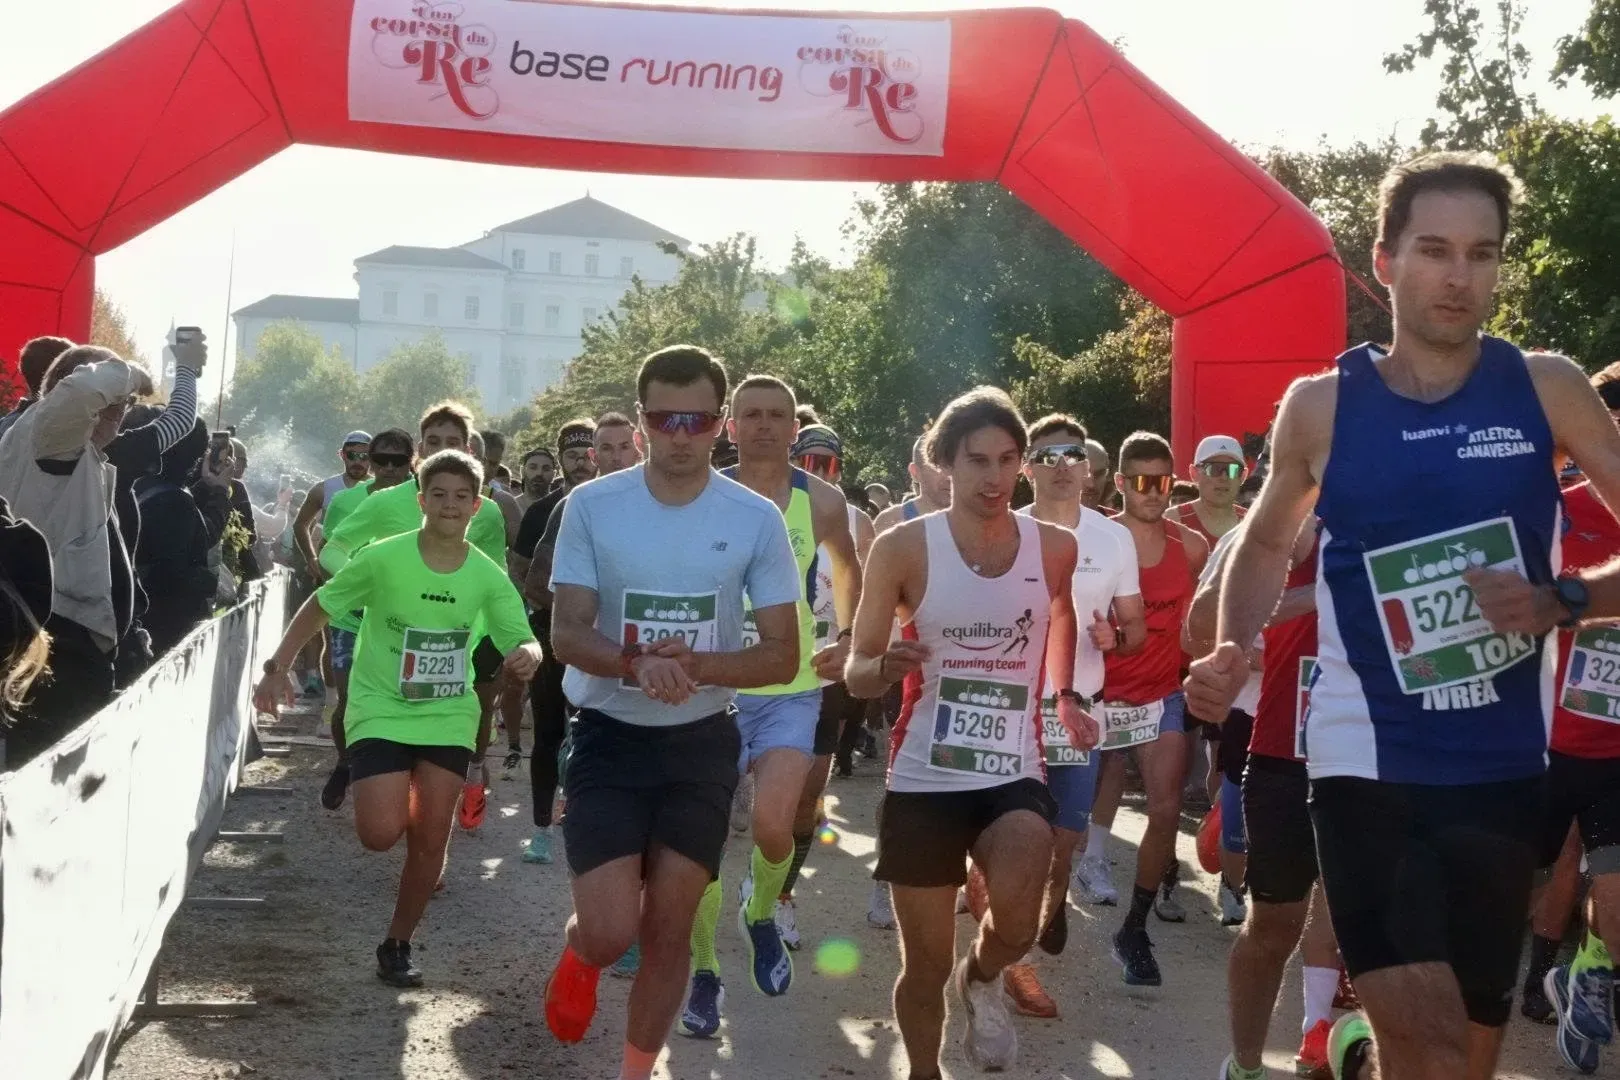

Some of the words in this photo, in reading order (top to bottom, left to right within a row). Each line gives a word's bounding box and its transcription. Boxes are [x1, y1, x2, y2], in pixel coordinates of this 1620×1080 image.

[370, 16, 463, 52] corsa
[509, 41, 610, 82] base
[620, 58, 783, 102] running
[797, 46, 888, 78] corsa
[402, 39, 499, 119] Re
[829, 66, 924, 143] Re
[1402, 425, 1450, 441] luanvi
[1468, 426, 1524, 444] ATLETICA
[1456, 441, 1536, 459] CANAVESANA
[1411, 585, 1481, 634] 522
[942, 622, 1013, 642] equilibra
[1465, 629, 1529, 671] 10K
[417, 656, 455, 675] 5229
[942, 658, 994, 672] running
[995, 659, 1027, 670] team
[432, 684, 464, 697] 10K
[1422, 678, 1501, 711] IVREA
[953, 709, 1006, 741] 5296
[1111, 707, 1149, 726] 5332
[1130, 725, 1156, 742] 10K
[974, 752, 1018, 775] 10K
[1056, 747, 1088, 762] 10K
